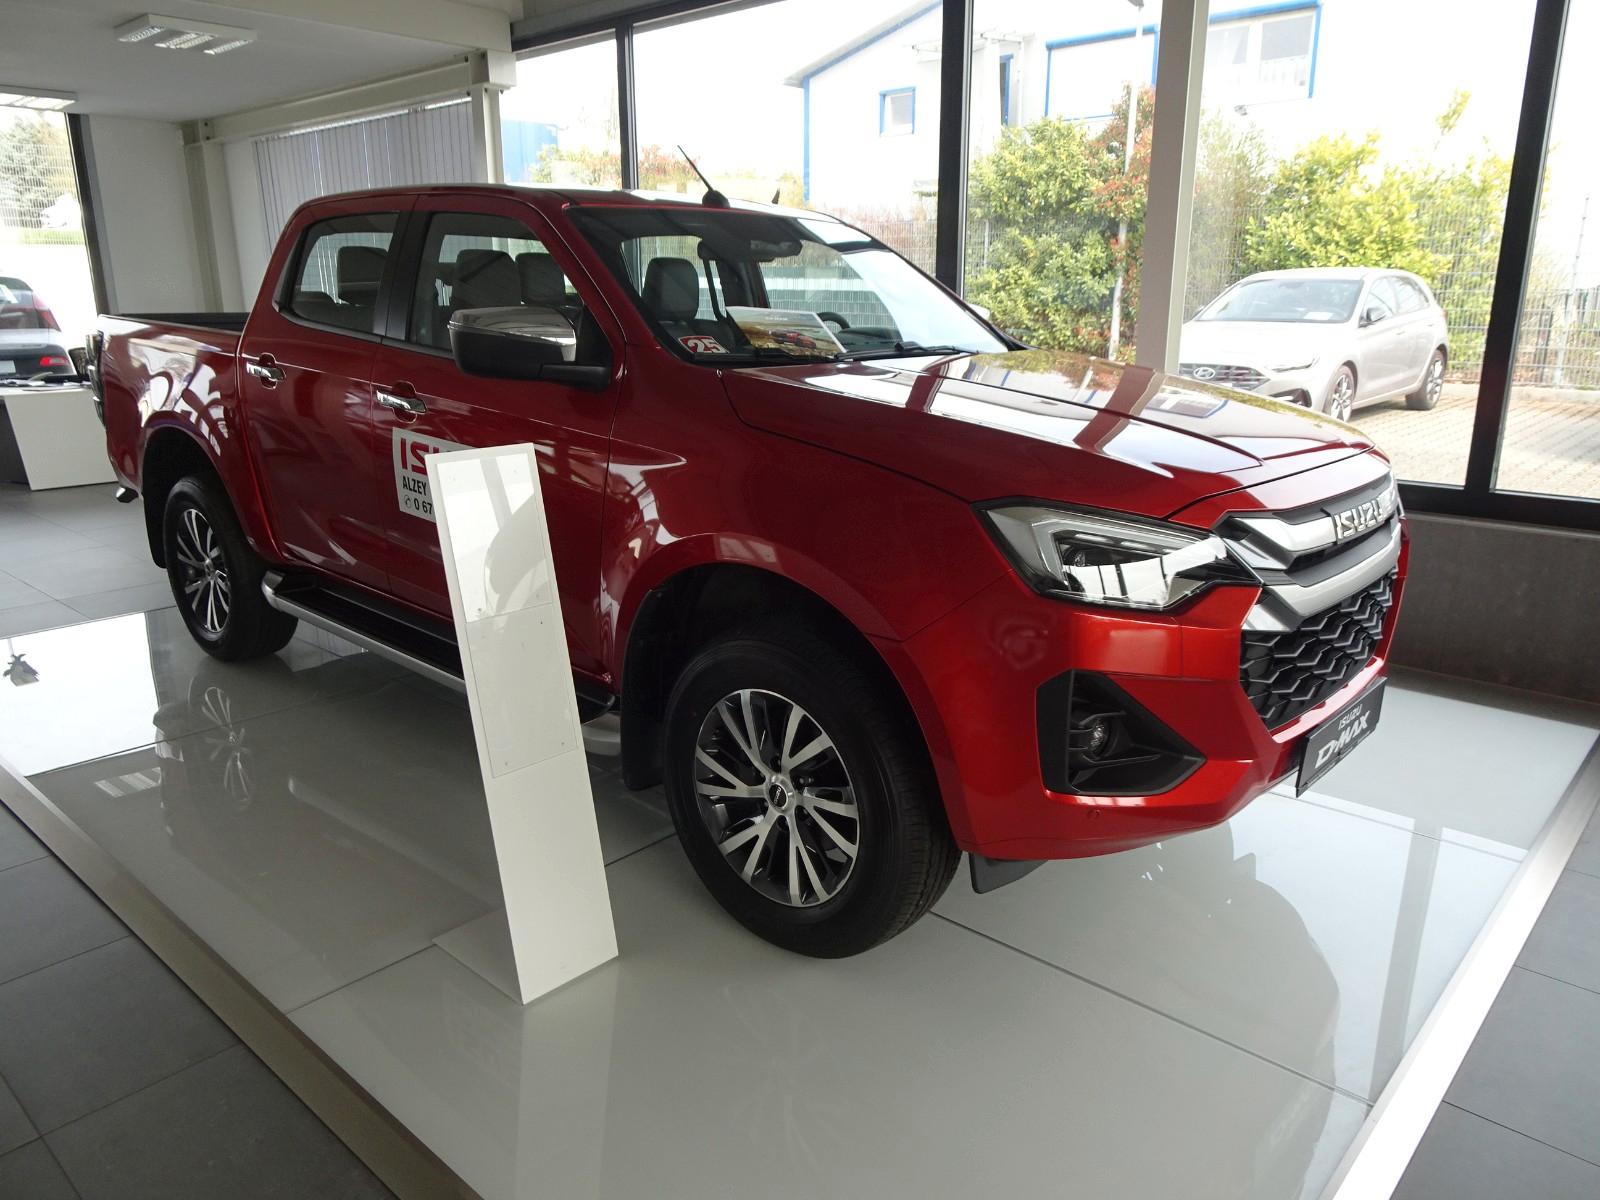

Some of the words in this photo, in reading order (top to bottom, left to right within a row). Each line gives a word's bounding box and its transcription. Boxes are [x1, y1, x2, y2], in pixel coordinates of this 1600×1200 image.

[687, 338, 727, 354] 25
[402, 475, 427, 496] ALZEY
[413, 497, 420, 511] 0
[1334, 500, 1384, 539] ISUZU
[1338, 703, 1363, 730] ISUZU
